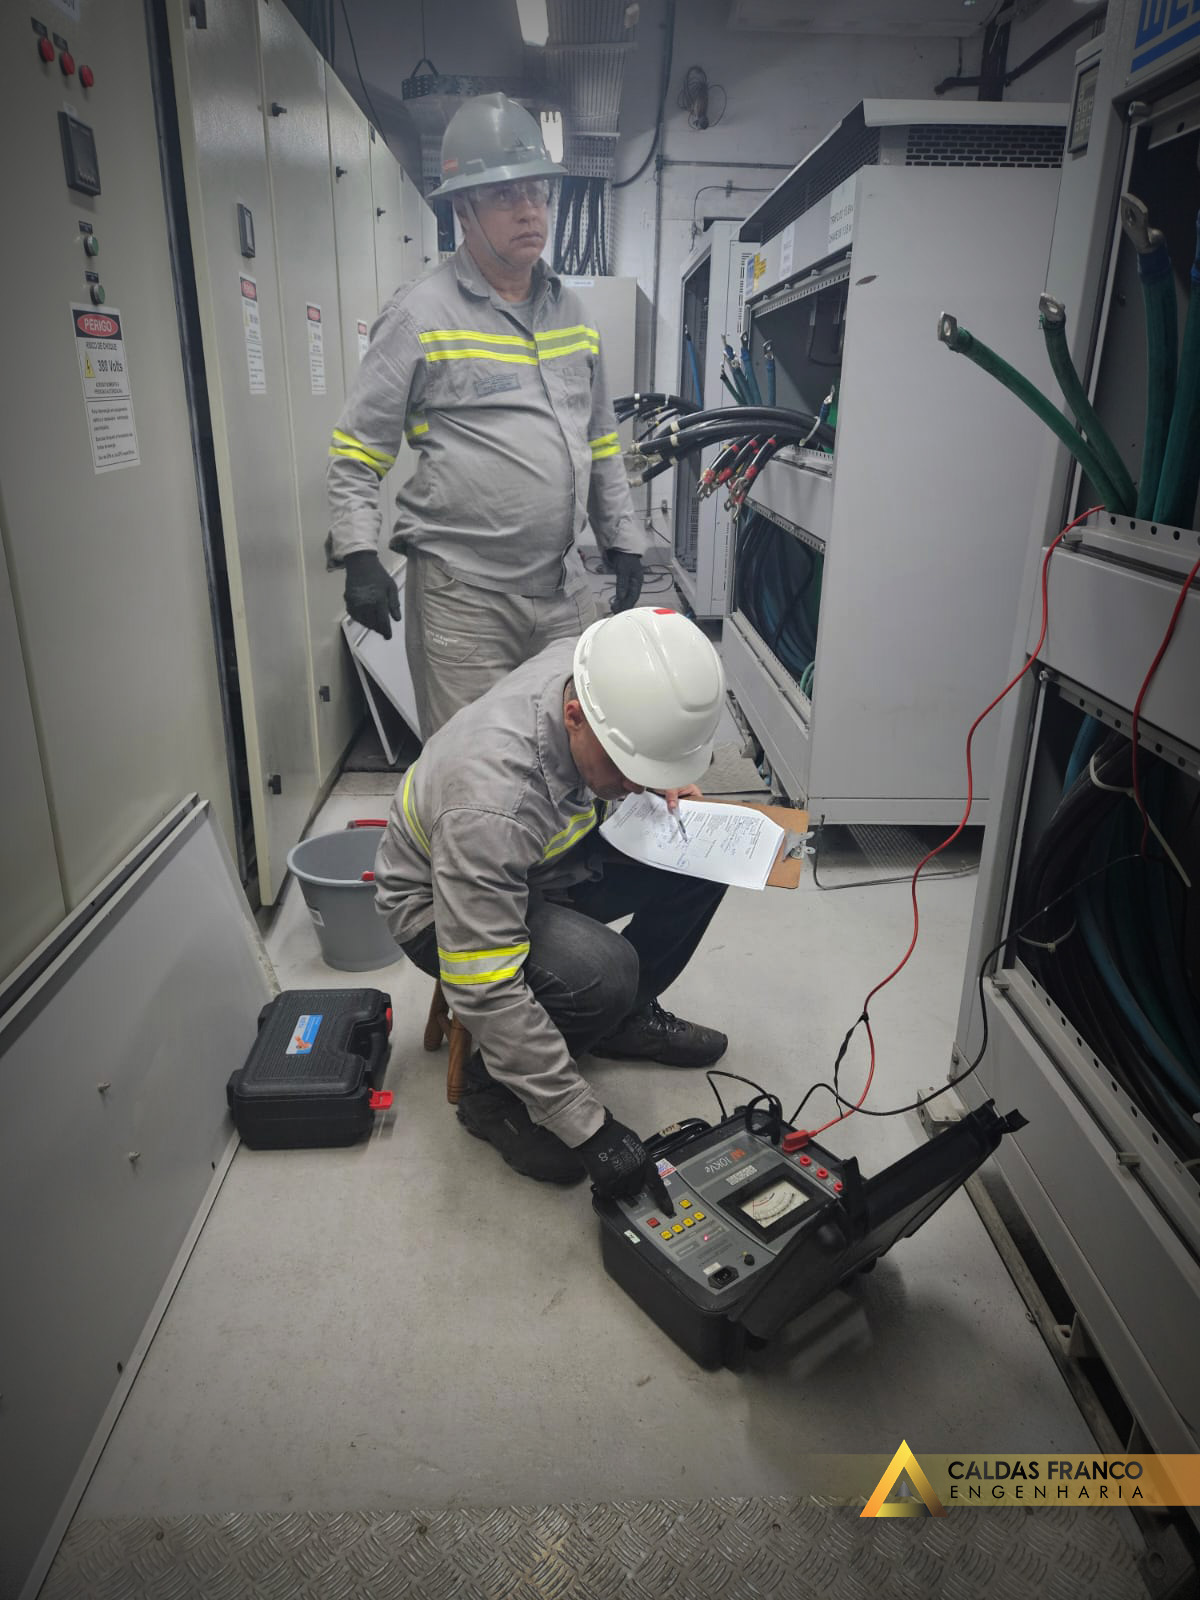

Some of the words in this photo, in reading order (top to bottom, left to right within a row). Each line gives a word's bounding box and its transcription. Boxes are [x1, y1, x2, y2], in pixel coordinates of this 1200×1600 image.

[83, 317, 112, 333] PERIGO
[97, 359, 108, 373] 380
[110, 359, 124, 373] Volts
